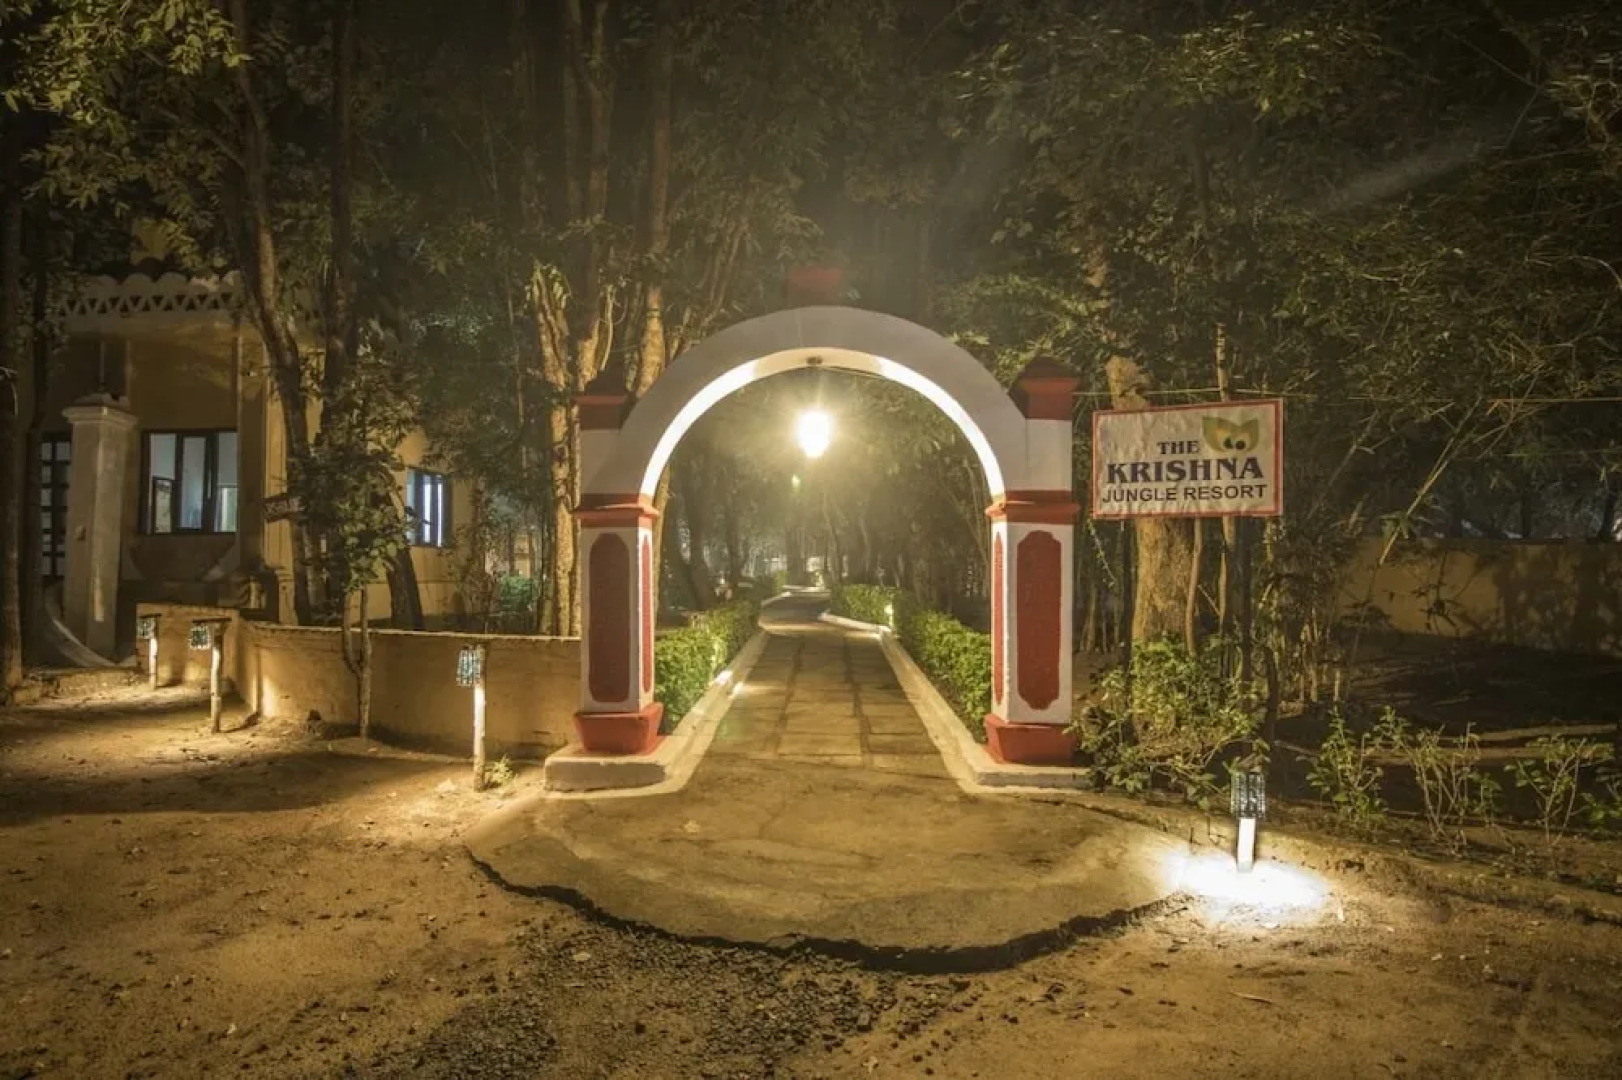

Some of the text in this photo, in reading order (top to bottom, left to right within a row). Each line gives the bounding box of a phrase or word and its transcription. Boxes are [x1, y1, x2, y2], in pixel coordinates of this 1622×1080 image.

[1157, 440, 1199, 455] THE
[1107, 456, 1264, 484] KRISHNA
[1102, 484, 1268, 503] JUNGLE RESORT
